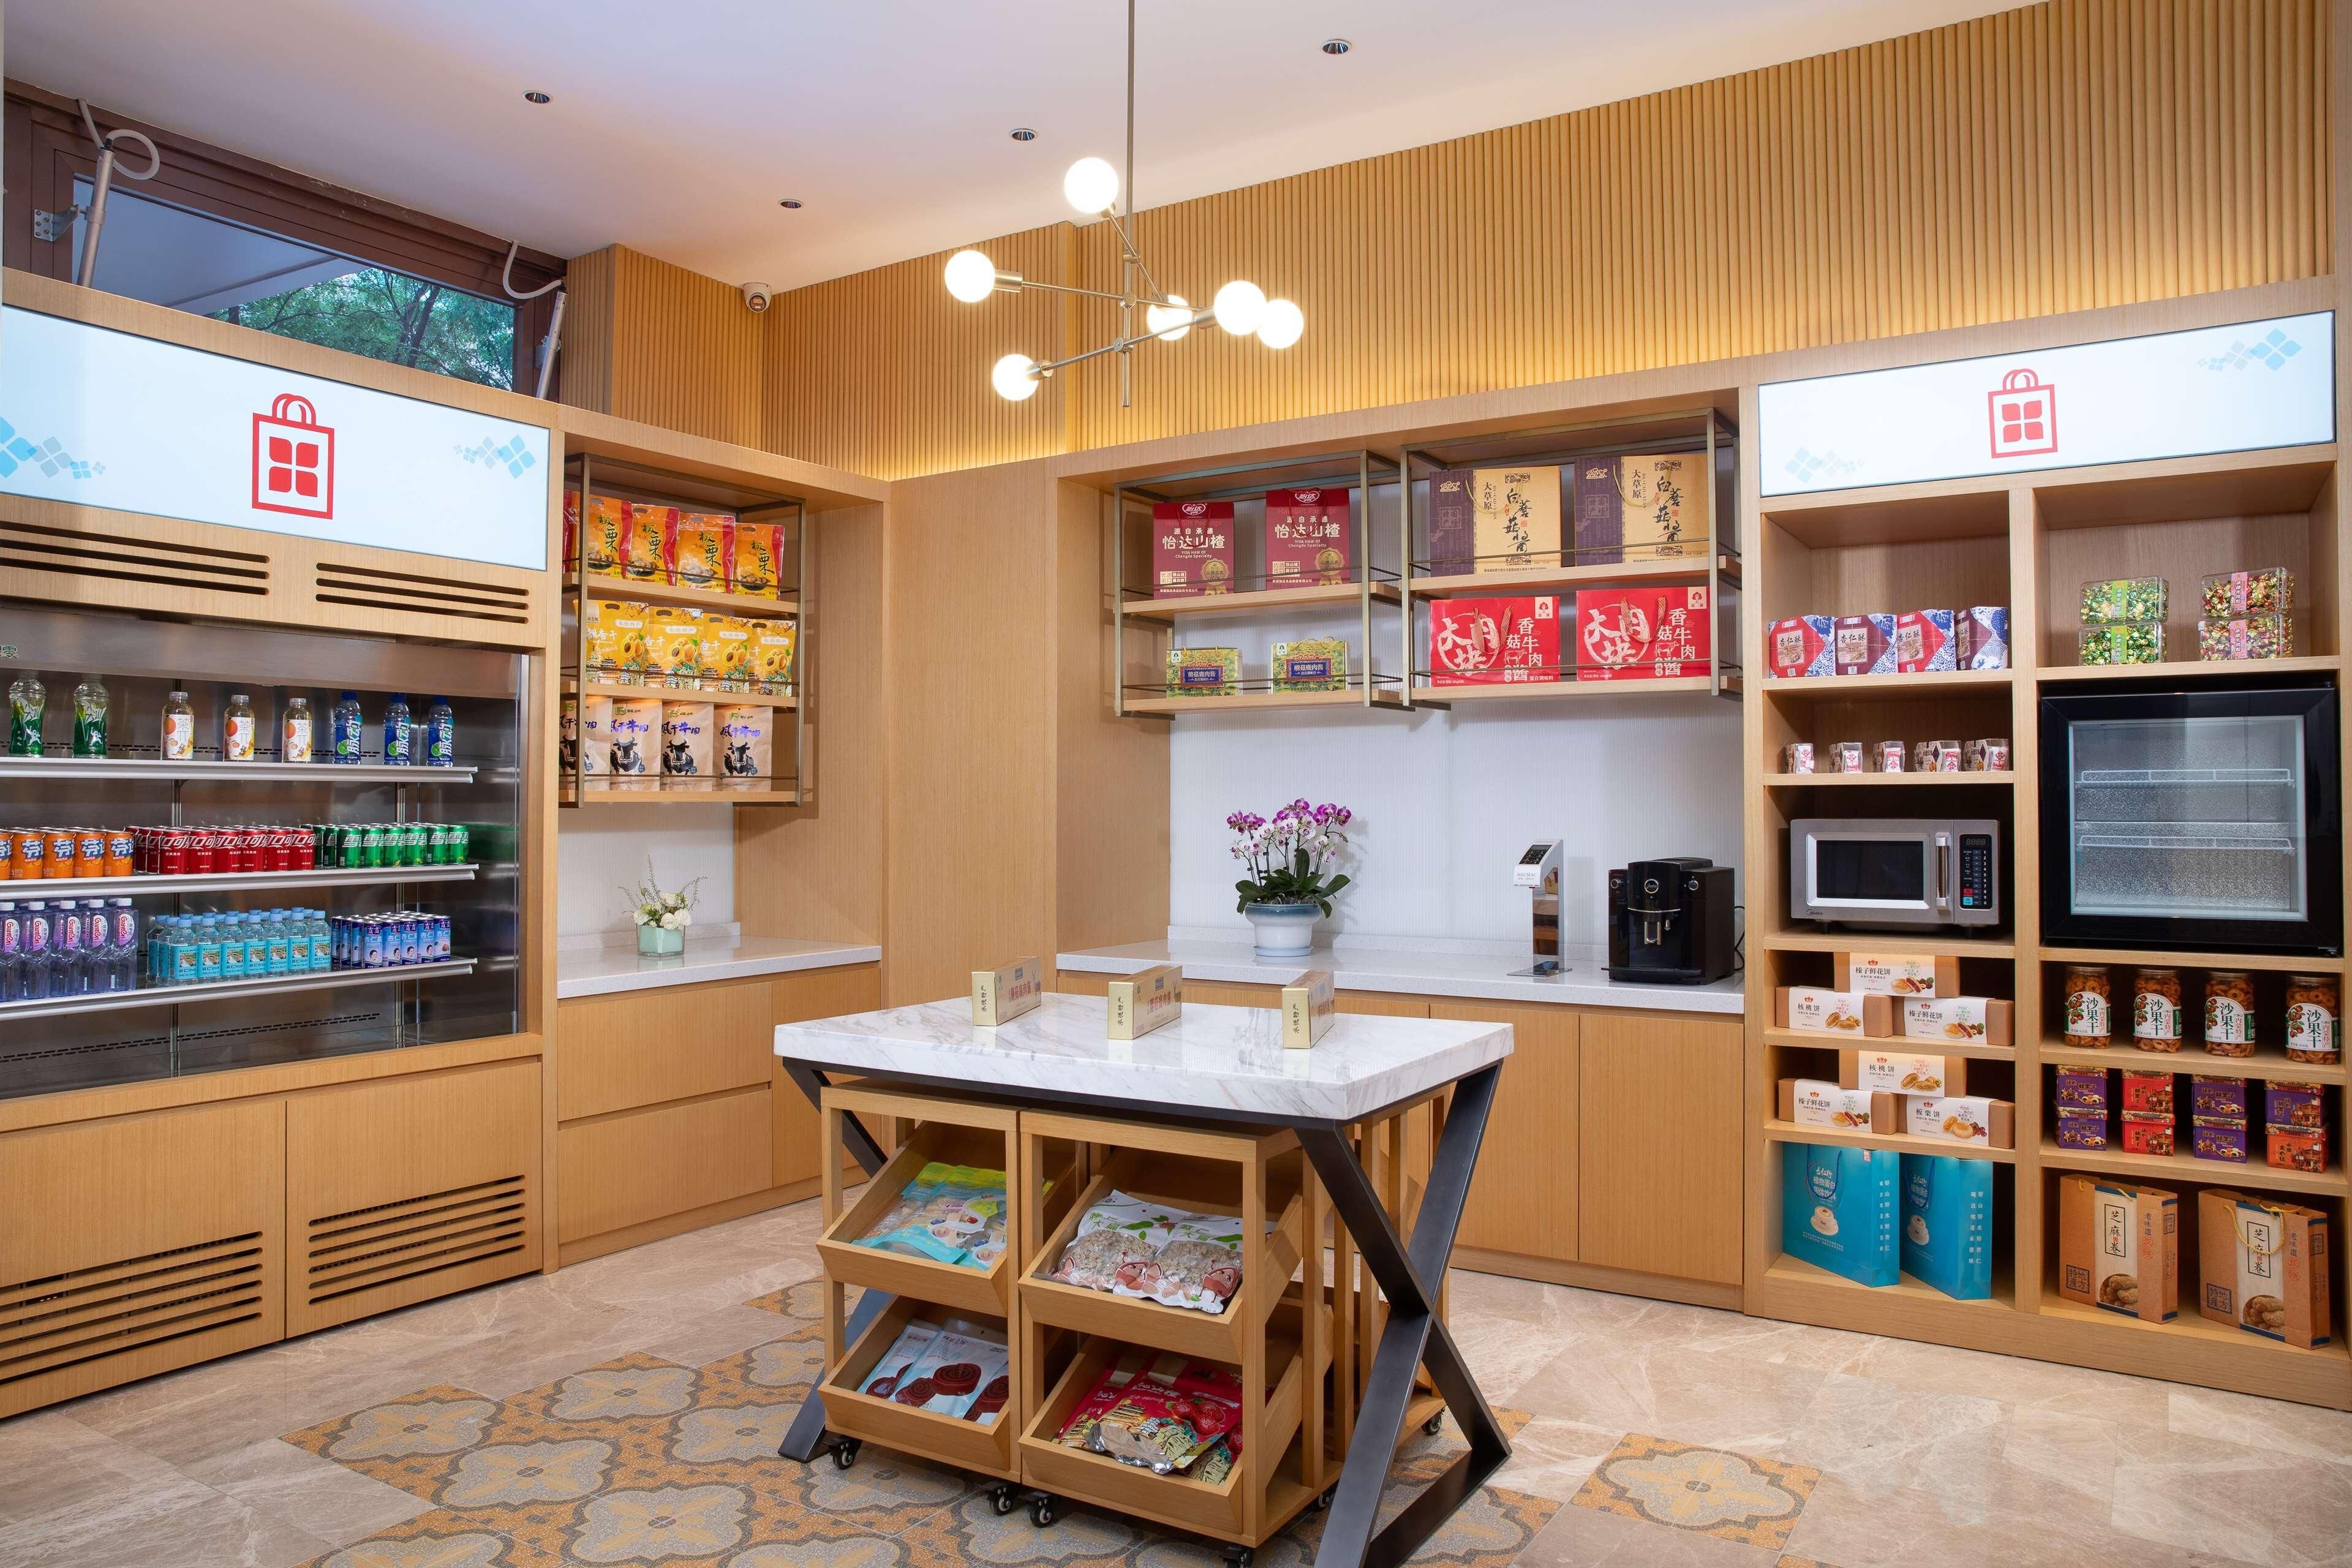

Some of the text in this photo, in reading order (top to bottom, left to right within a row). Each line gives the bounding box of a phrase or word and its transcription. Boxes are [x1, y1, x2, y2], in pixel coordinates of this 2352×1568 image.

[1483, 482, 1493, 510] 大草原
[1632, 469, 1642, 499] 大草原
[598, 515, 618, 552] 板栗
[642, 523, 662, 560] 板栗
[1163, 535, 1224, 549] 怡达山楂
[1275, 523, 1340, 538] 怡达山楂
[698, 532, 722, 567] 板栗
[750, 540, 775, 575] 板栗
[1780, 636, 1801, 646] 杏仁酥
[1841, 633, 1866, 643] 杏仁酥
[1898, 630, 1920, 642] 杏仁酥
[346, 720, 361, 755] 脉动
[396, 722, 410, 755] 脉动
[439, 723, 454, 756] 脉动
[1856, 967, 1891, 975] 榛子鲜花饼
[1798, 1003, 1820, 1012] 核桃饼
[1909, 1009, 1942, 1019] 榛子鲜花饼
[2086, 997, 2098, 1033] 沙果干
[2150, 999, 2163, 1036] 沙果干
[2220, 1003, 2234, 1040] 沙果干
[2307, 1009, 2321, 1048] 沙果干
[1869, 1064, 1894, 1072] 核桃饼
[1798, 1097, 1831, 1108] 榛子鲜花饼
[1916, 1108, 1940, 1118] 板栗饼
[1975, 1191, 1984, 1264] 好山好水好杏仁
[2108, 1210, 2122, 1254] 芝麻卷
[2252, 1228, 2266, 1275] 芝麻卷
